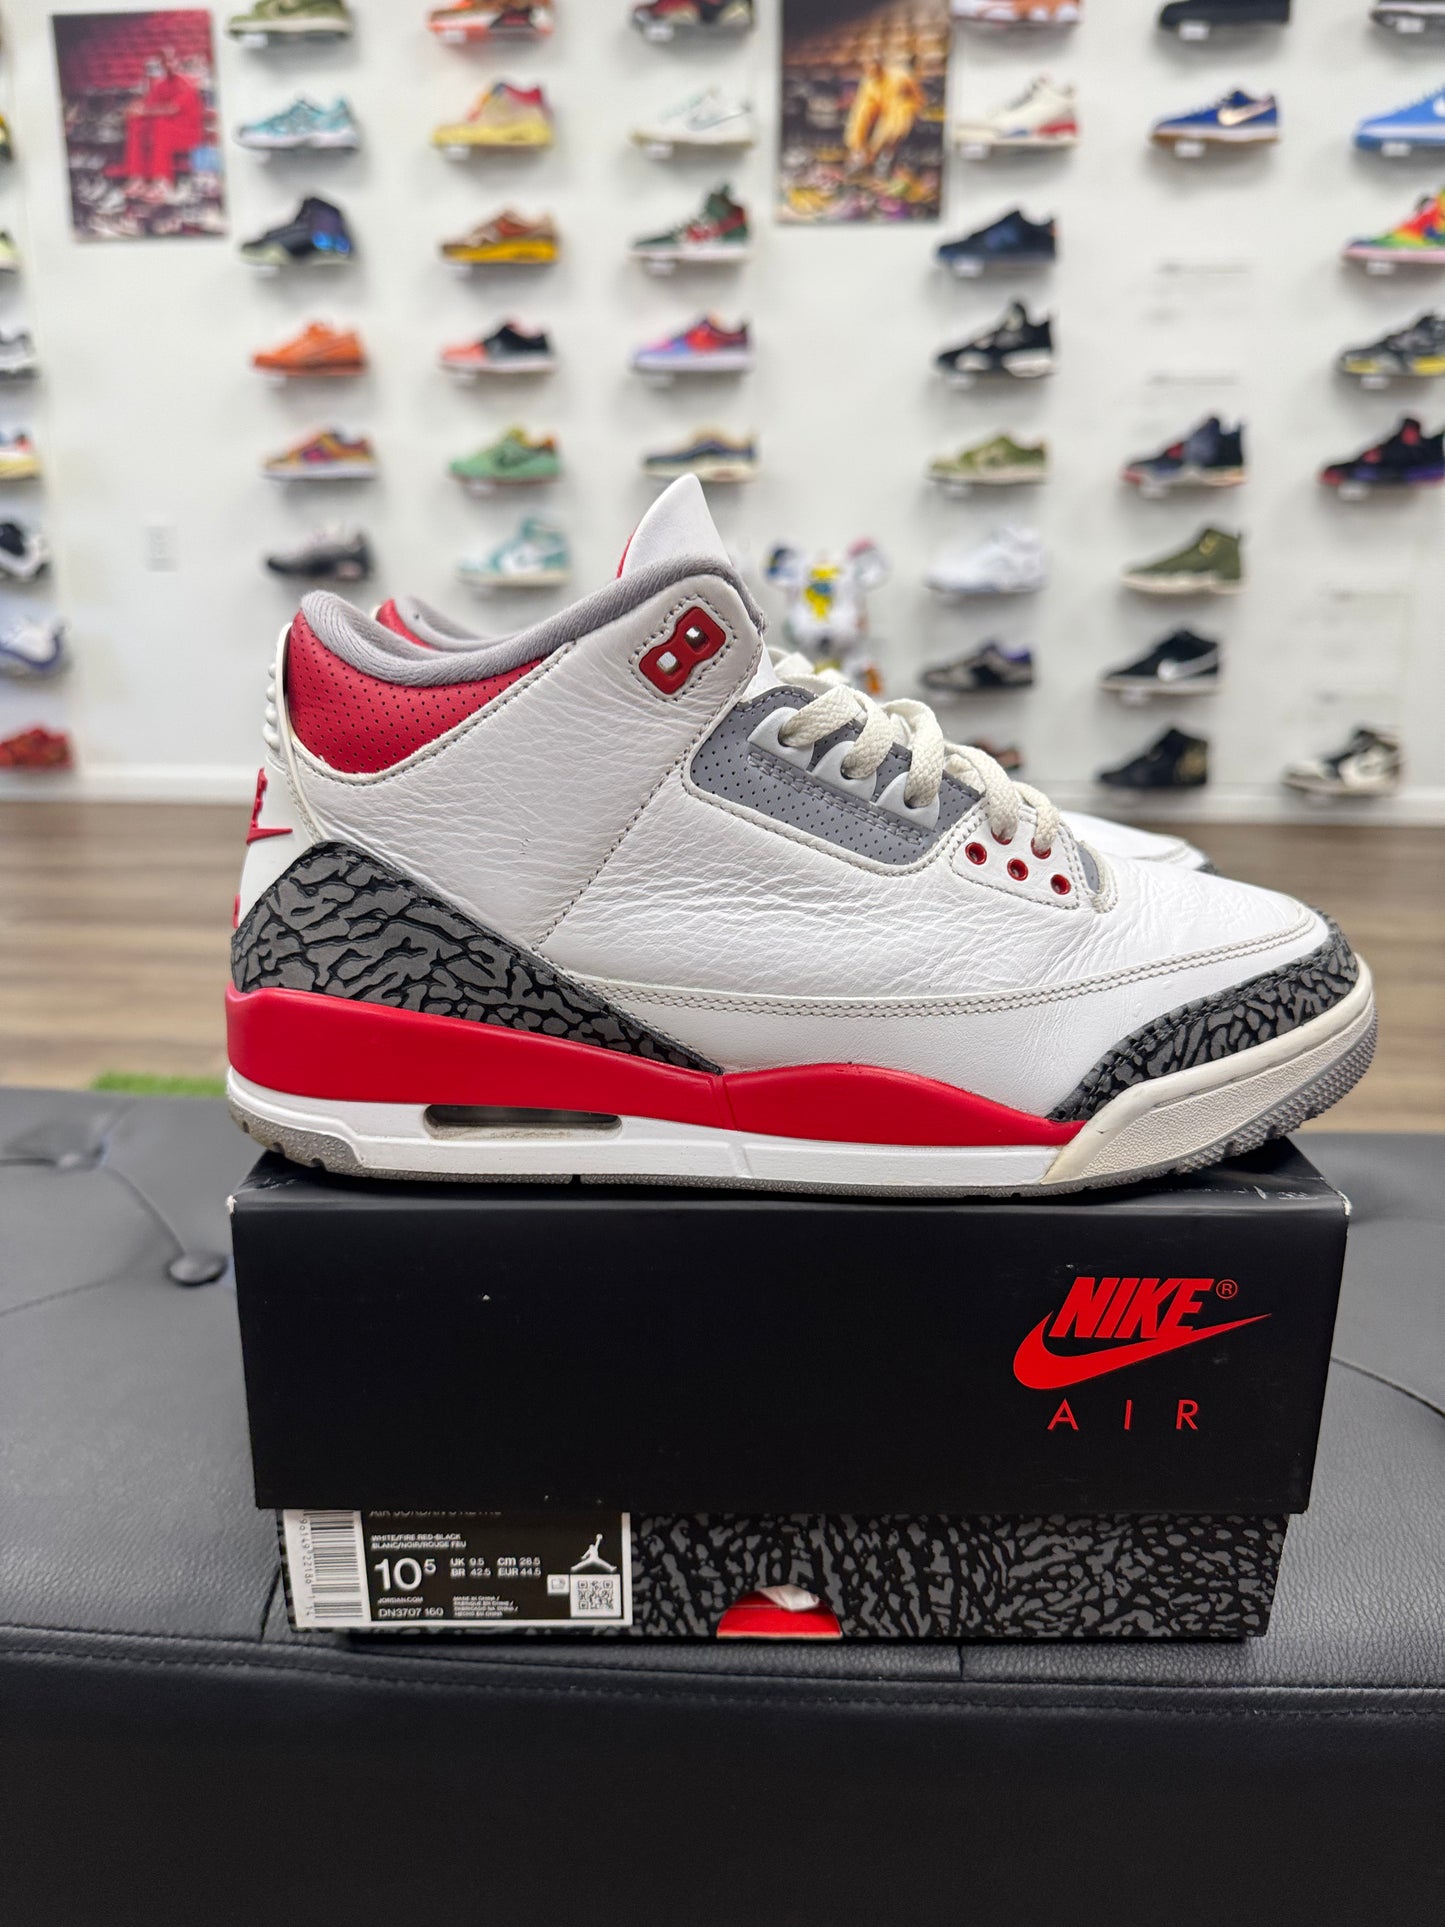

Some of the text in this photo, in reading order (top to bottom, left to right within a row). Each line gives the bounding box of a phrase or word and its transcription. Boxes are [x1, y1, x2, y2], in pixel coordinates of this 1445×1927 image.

[1048, 1276, 1215, 1339] NIKE
[1047, 1398, 1199, 1431] AIR
[450, 1557, 466, 1567] UK
[497, 1556, 541, 1566] cm 28.5
[450, 1567, 492, 1578] BR 42.5
[498, 1567, 542, 1577] EUR 44.5
[378, 1607, 444, 1618] DN3707 160
